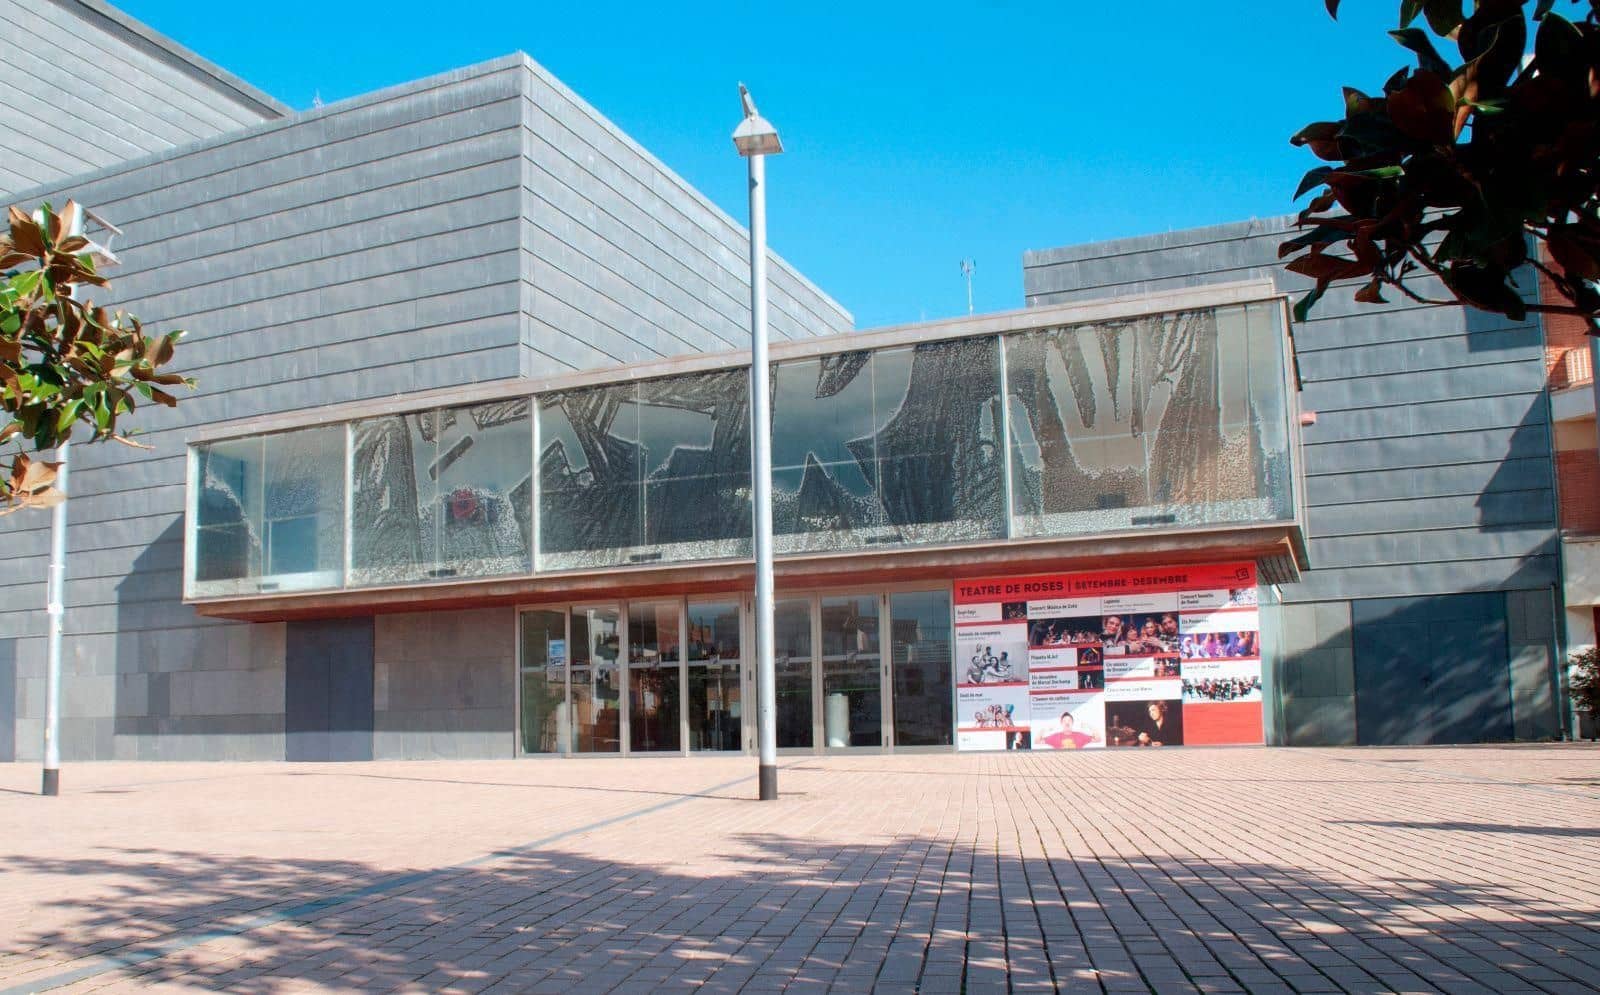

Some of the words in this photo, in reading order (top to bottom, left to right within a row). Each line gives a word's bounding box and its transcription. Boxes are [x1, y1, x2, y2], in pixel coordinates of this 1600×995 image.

[960, 585, 1002, 597] TEATRE
[1005, 583, 1020, 594] DE
[1023, 581, 1064, 593] ROSES
